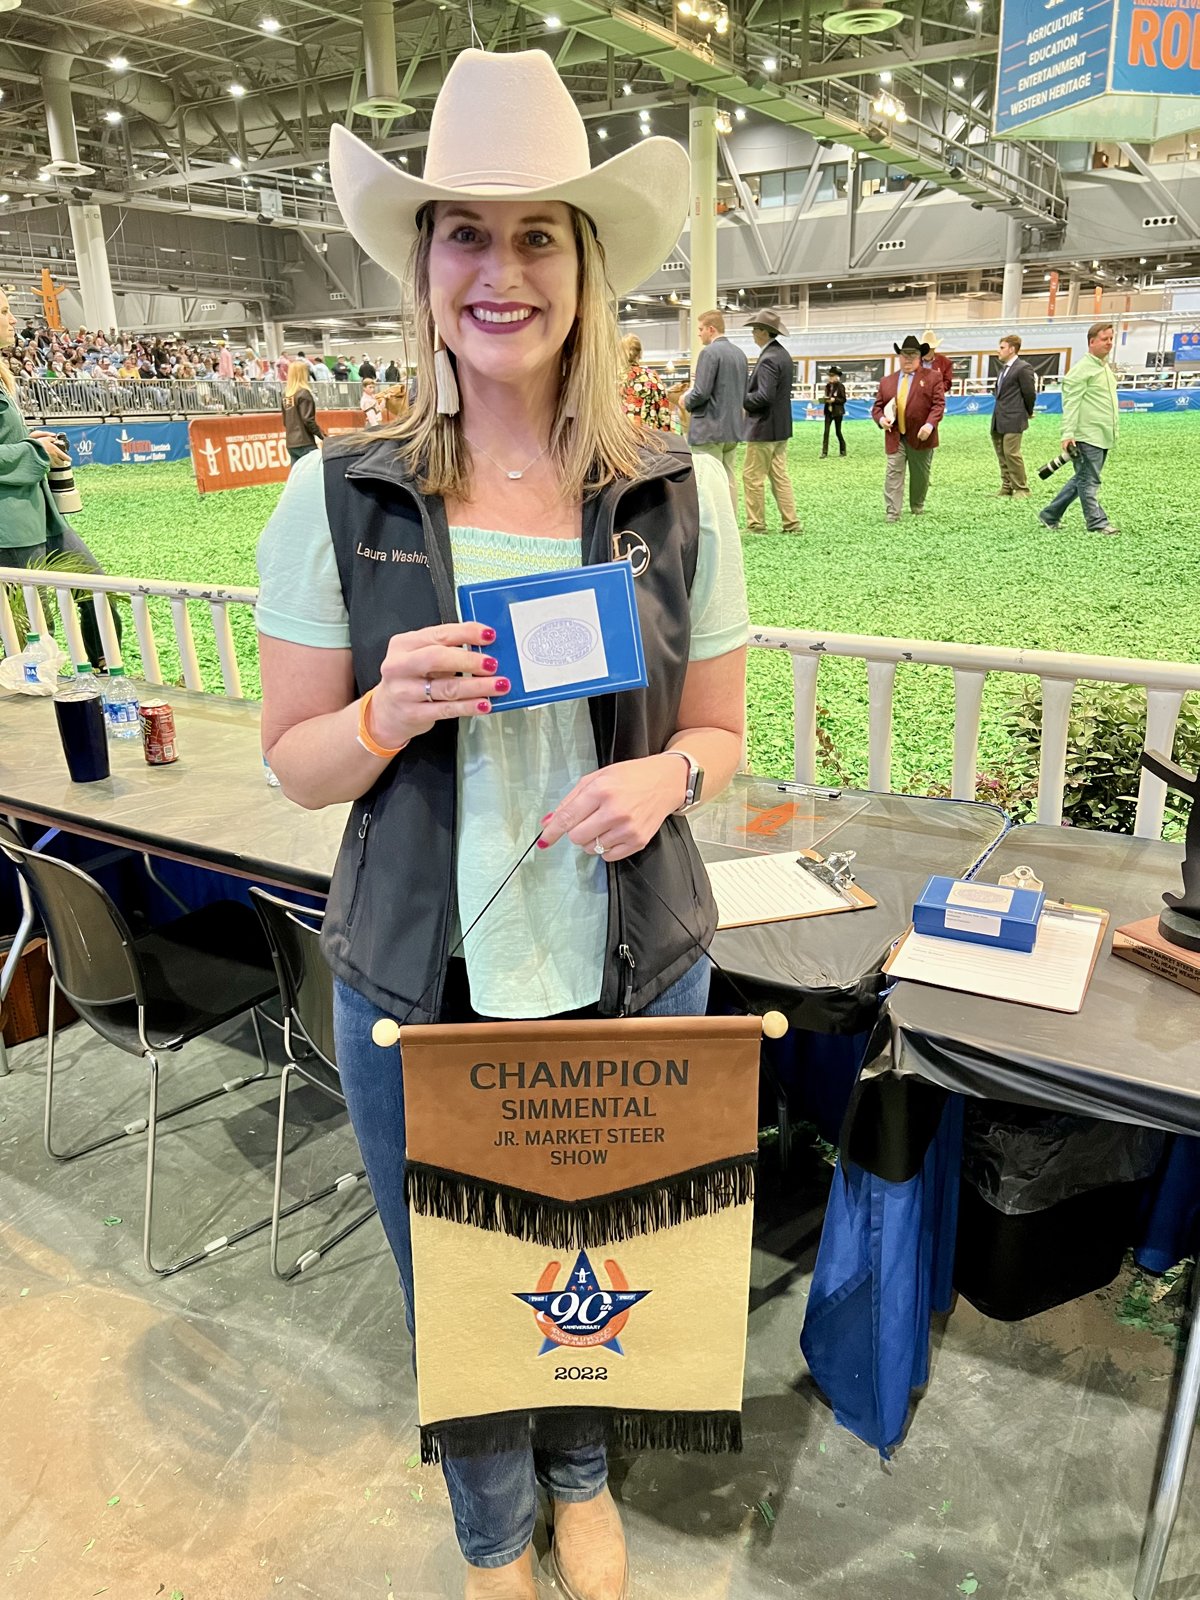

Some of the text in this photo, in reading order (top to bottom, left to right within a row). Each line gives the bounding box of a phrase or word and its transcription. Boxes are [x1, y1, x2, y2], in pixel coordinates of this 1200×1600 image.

[1026, 7, 1085, 46] AGRICULTURE
[1029, 33, 1078, 66] EDUCATION
[1018, 51, 1087, 92] ENTERTAINMENT
[1010, 72, 1092, 116] WESTERN HERITAGE
[227, 440, 291, 473] RODEO
[356, 542, 387, 561] Laura
[1154, 950, 1176, 964] MARKET
[470, 1059, 689, 1090] CHAMPION
[502, 1097, 657, 1120] SIMMENTAL
[494, 1127, 665, 1146] JR. MARKET STEER
[550, 1149, 608, 1166] SHOW
[554, 1366, 608, 1380] 2022
